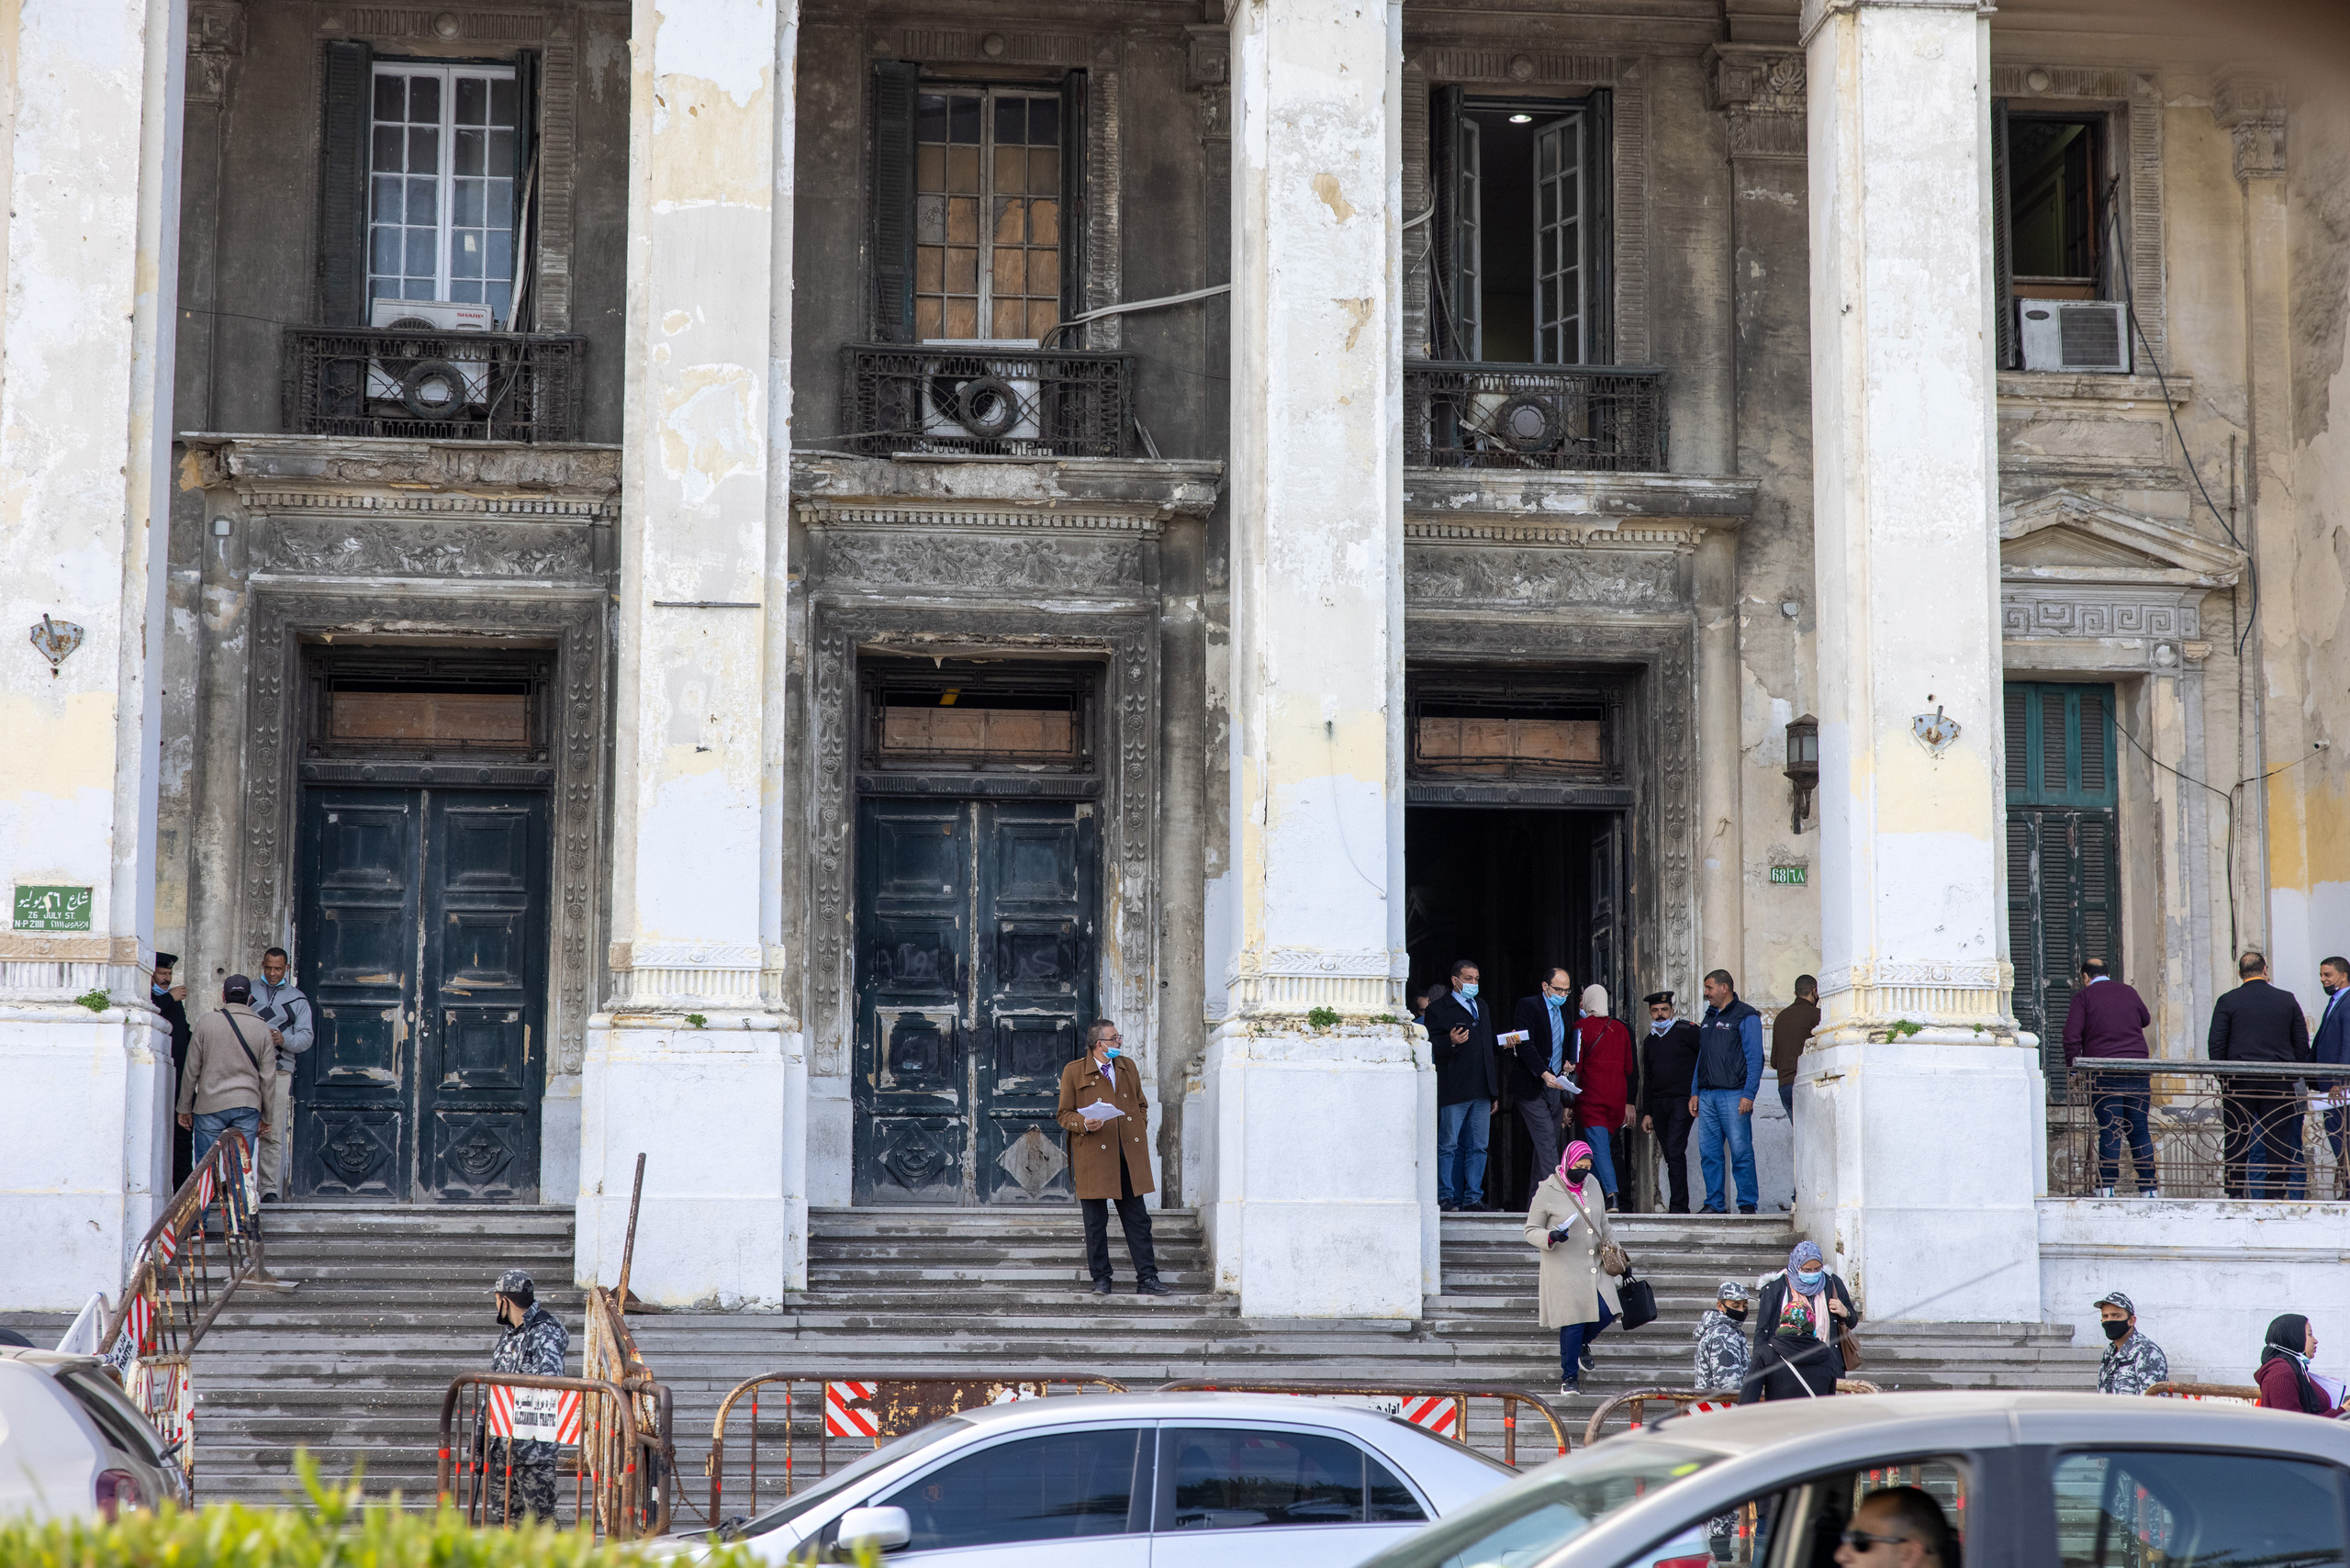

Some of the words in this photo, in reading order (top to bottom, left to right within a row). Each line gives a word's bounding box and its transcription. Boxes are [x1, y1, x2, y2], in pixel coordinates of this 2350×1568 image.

[1772, 868, 1786, 883] 68
[17, 890, 46, 910] يوليو
[47, 891, 62, 908] ٢٦
[66, 890, 89, 911] شارع
[28, 911, 38, 919] 26
[43, 912, 62, 920] JULY
[118, 1340, 134, 1371] TRAFFIC
[539, 1412, 556, 1428] TRAFFIC
